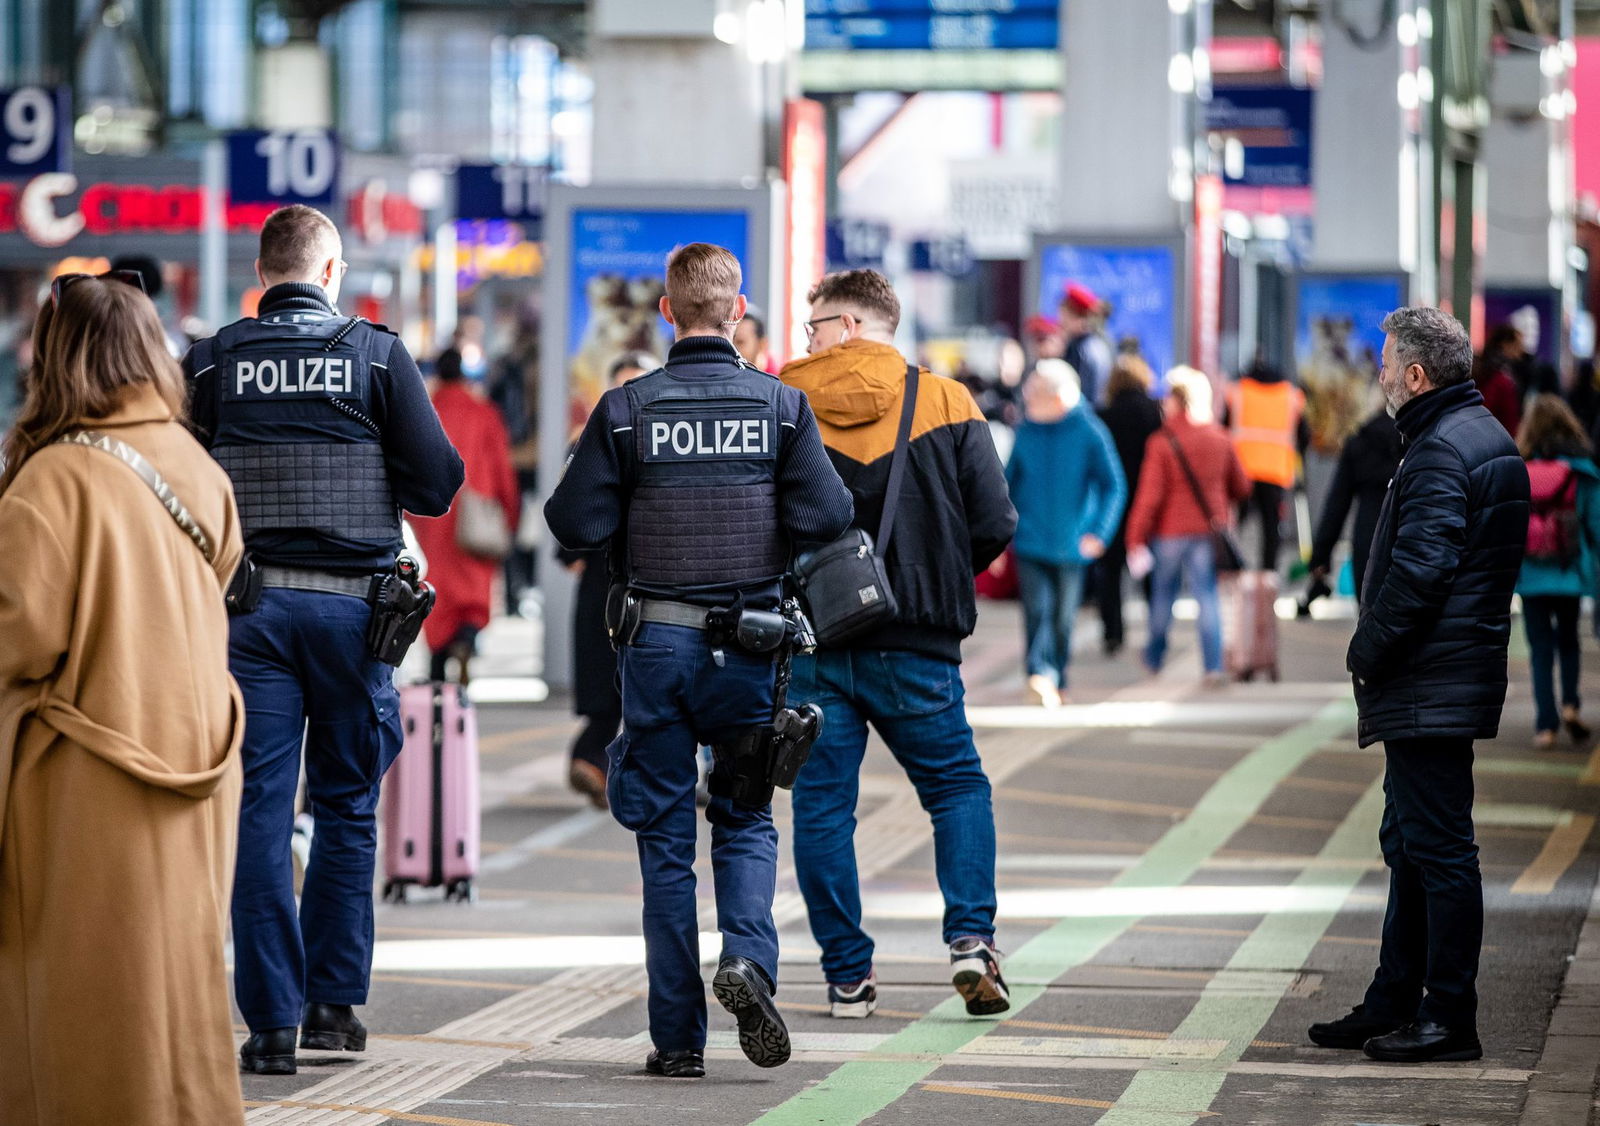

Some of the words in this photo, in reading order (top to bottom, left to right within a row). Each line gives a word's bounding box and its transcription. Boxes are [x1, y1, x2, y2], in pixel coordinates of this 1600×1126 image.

[4, 86, 55, 165] 9
[255, 132, 335, 197] 10
[236, 357, 352, 396] POLIZEI
[651, 419, 769, 456] POLIZEI
